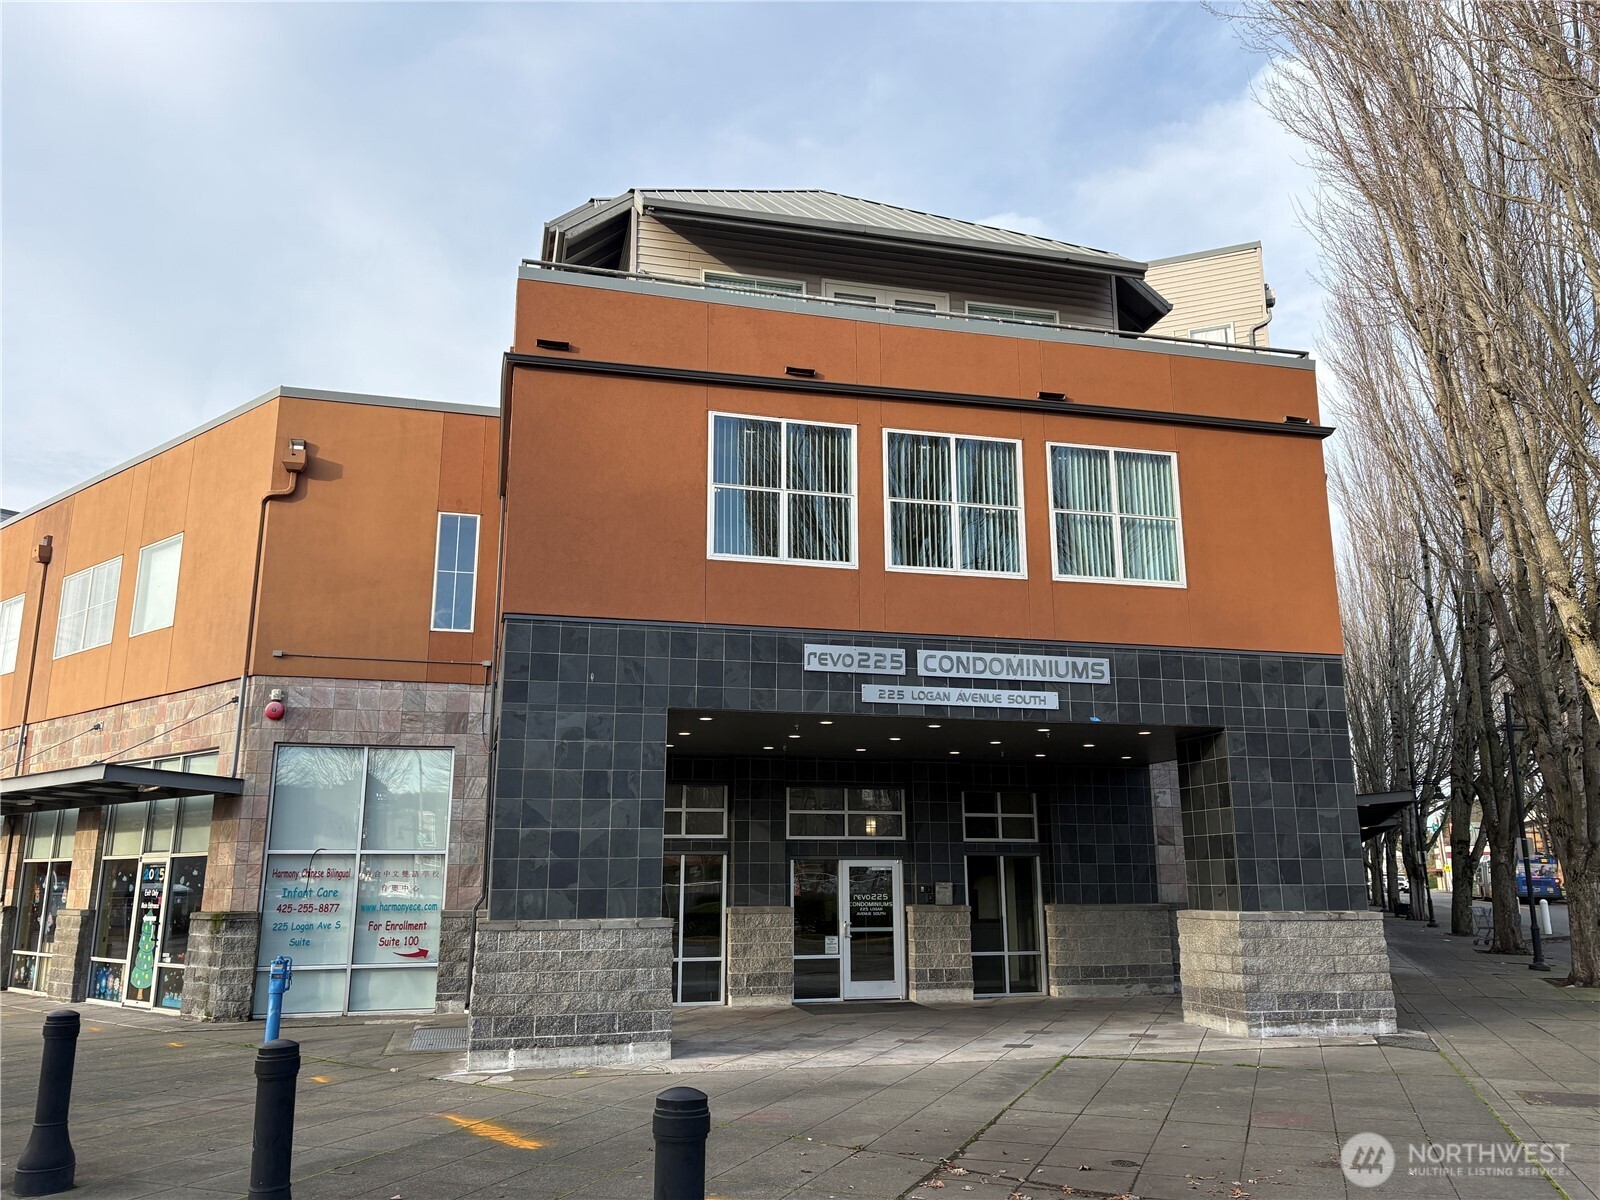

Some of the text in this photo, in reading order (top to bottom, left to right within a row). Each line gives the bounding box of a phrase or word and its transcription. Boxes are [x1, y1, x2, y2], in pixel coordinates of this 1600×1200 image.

[923, 653, 1106, 680] CONDOMINIUMS
[878, 689, 1047, 706] 225 LOGAN AVENUE SOUTH
[143, 868, 165, 881] 2025
[272, 867, 351, 880] Harmony Chinese Bilingual
[282, 887, 339, 898] Infant Care
[276, 903, 340, 913] 425-255-8877
[360, 901, 438, 914] www.harmonyece.com
[272, 920, 341, 933] 225 Logan Ave S
[368, 920, 428, 931] For Enrollment
[289, 938, 311, 947] Suite
[378, 936, 420, 947] Suite 100
